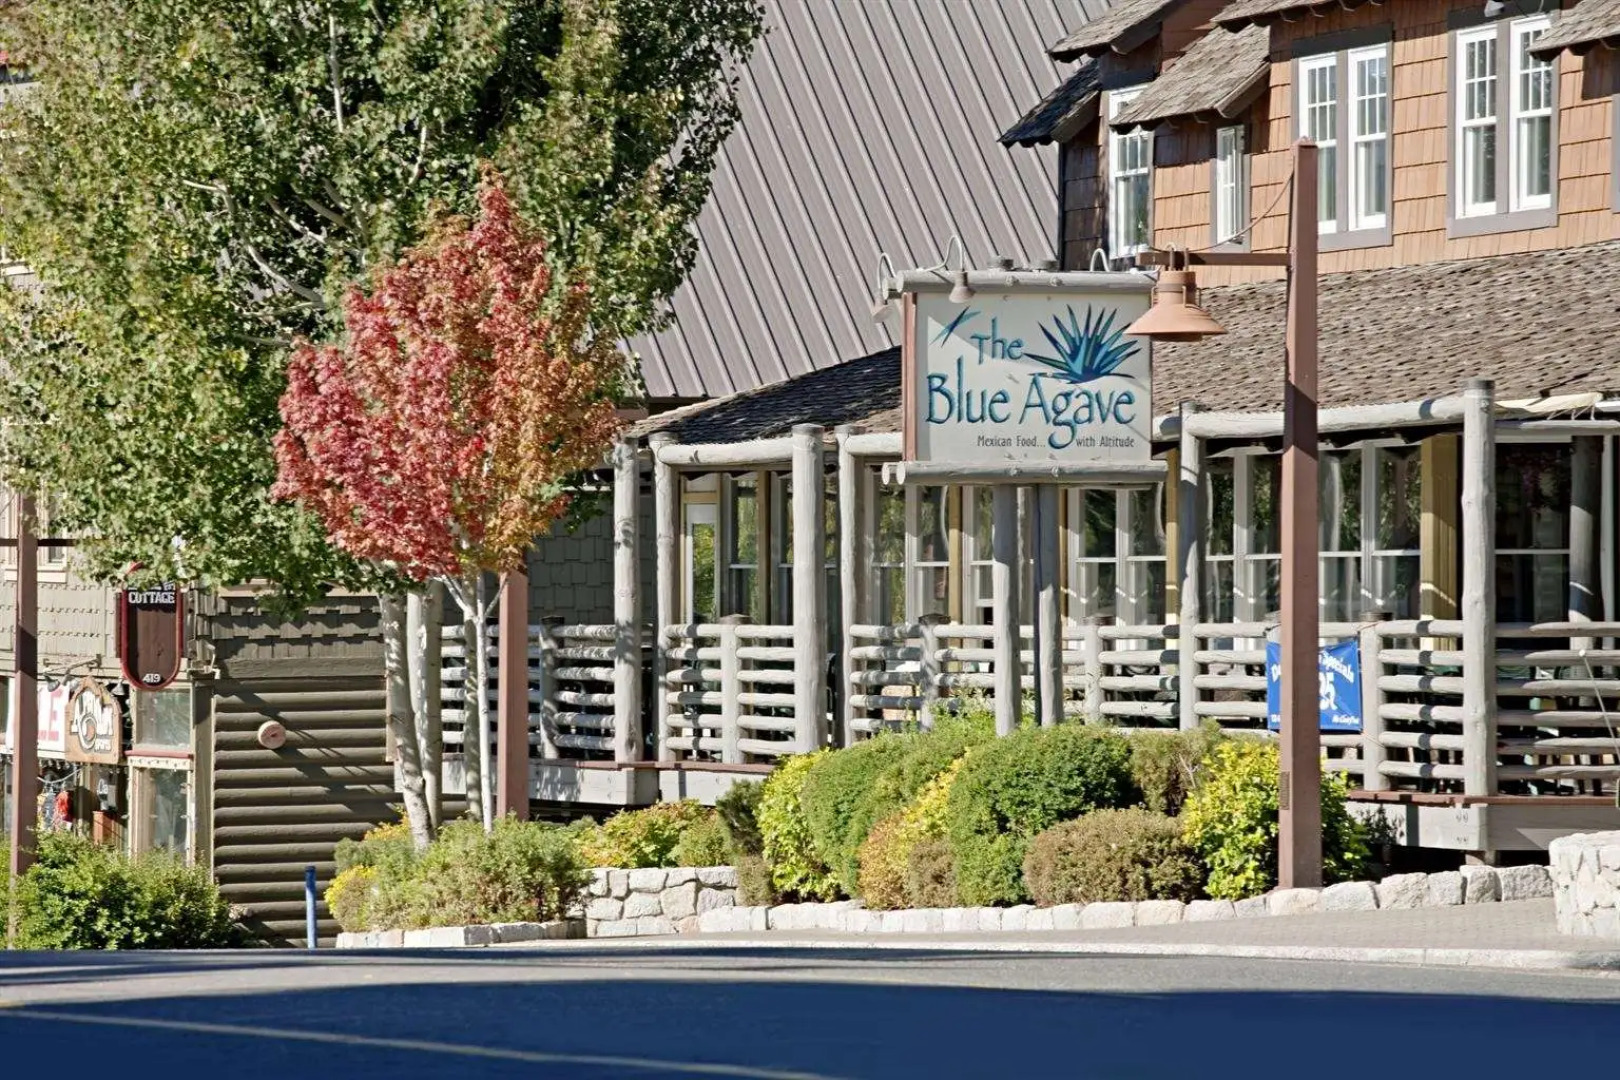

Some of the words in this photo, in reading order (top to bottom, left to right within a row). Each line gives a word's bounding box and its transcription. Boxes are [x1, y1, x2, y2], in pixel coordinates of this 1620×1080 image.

[971, 316, 1024, 365] The
[926, 355, 1012, 425] Blue
[1019, 373, 1136, 449] Agave
[977, 435, 1012, 447] Mexican
[1076, 435, 1096, 447] with
[1100, 435, 1135, 447] Altitude
[128, 591, 176, 604] COTTAGE
[142, 673, 161, 683] 419
